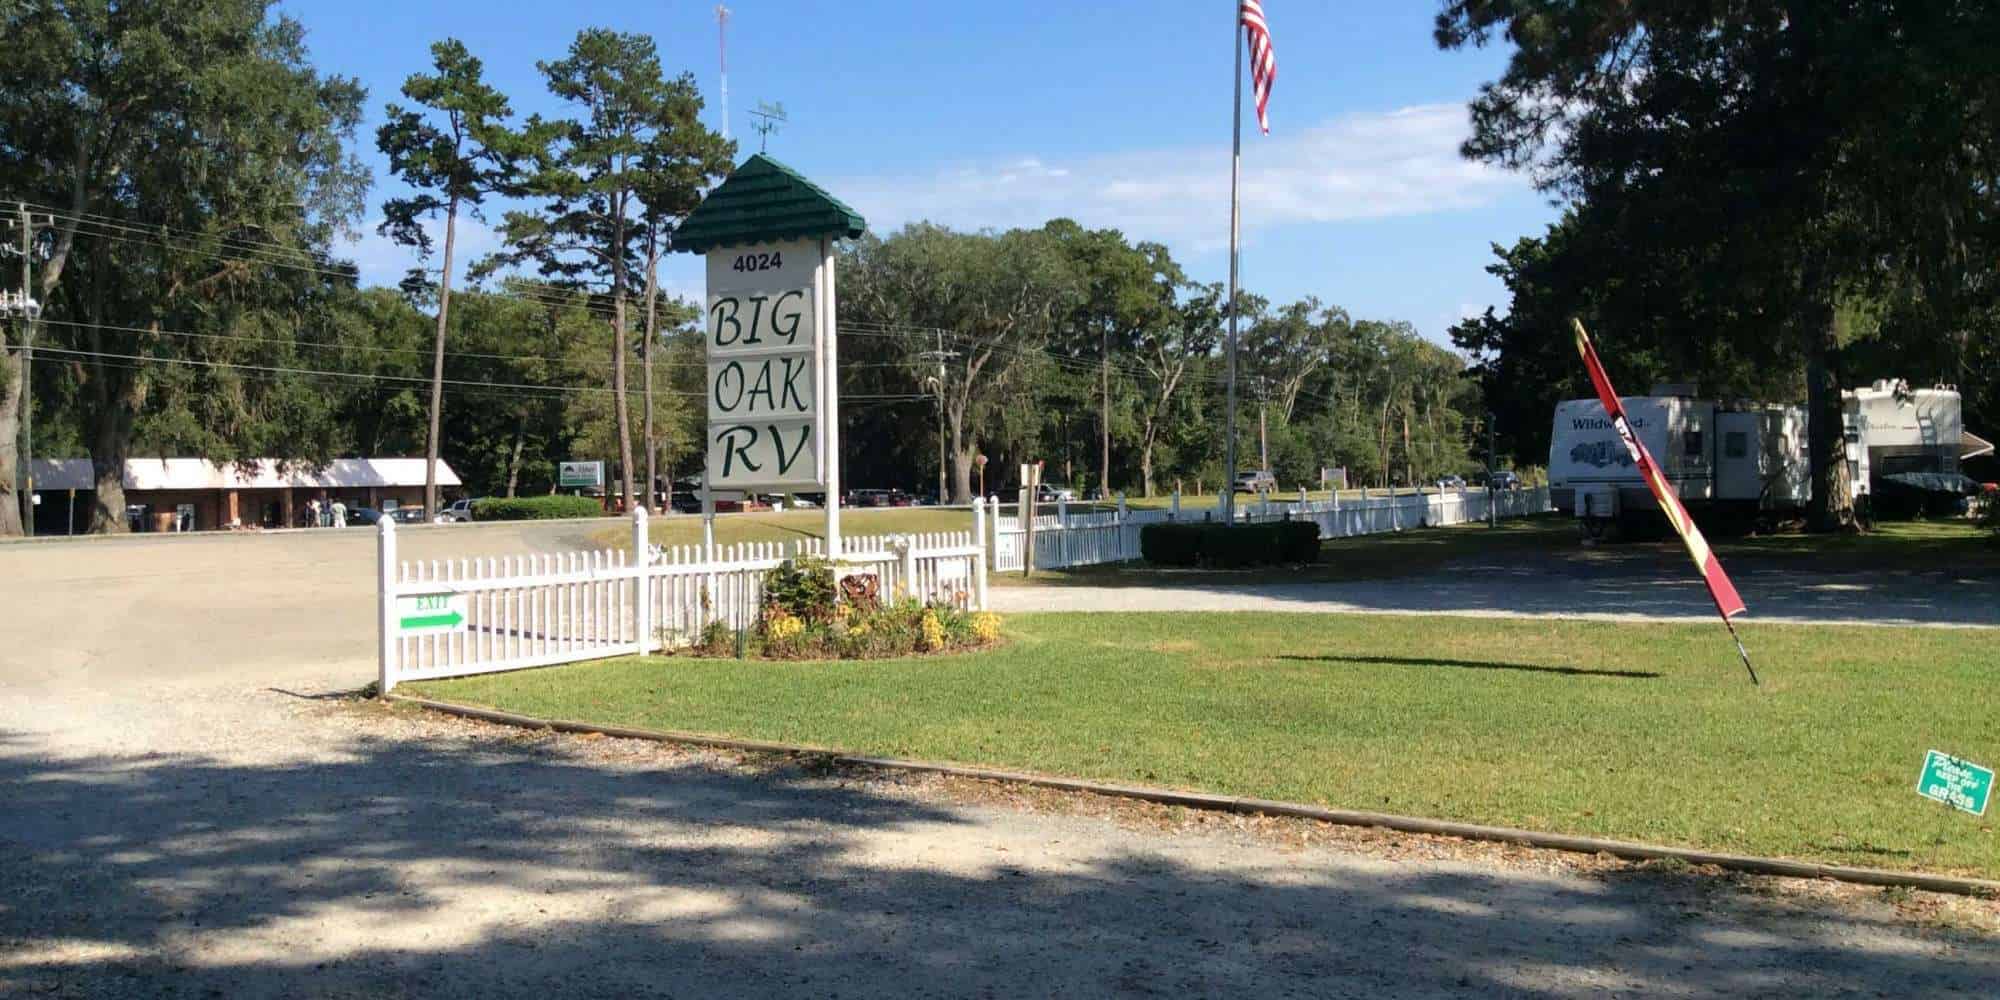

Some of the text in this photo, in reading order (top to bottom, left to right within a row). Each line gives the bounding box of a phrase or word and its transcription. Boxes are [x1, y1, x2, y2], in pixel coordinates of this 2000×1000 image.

[733, 252, 783, 272] 4024
[711, 290, 804, 346] BIG
[714, 358, 808, 412] OAK
[1573, 418, 1643, 430] Wildwd
[716, 424, 810, 478] RV
[416, 594, 449, 610] EXIT
